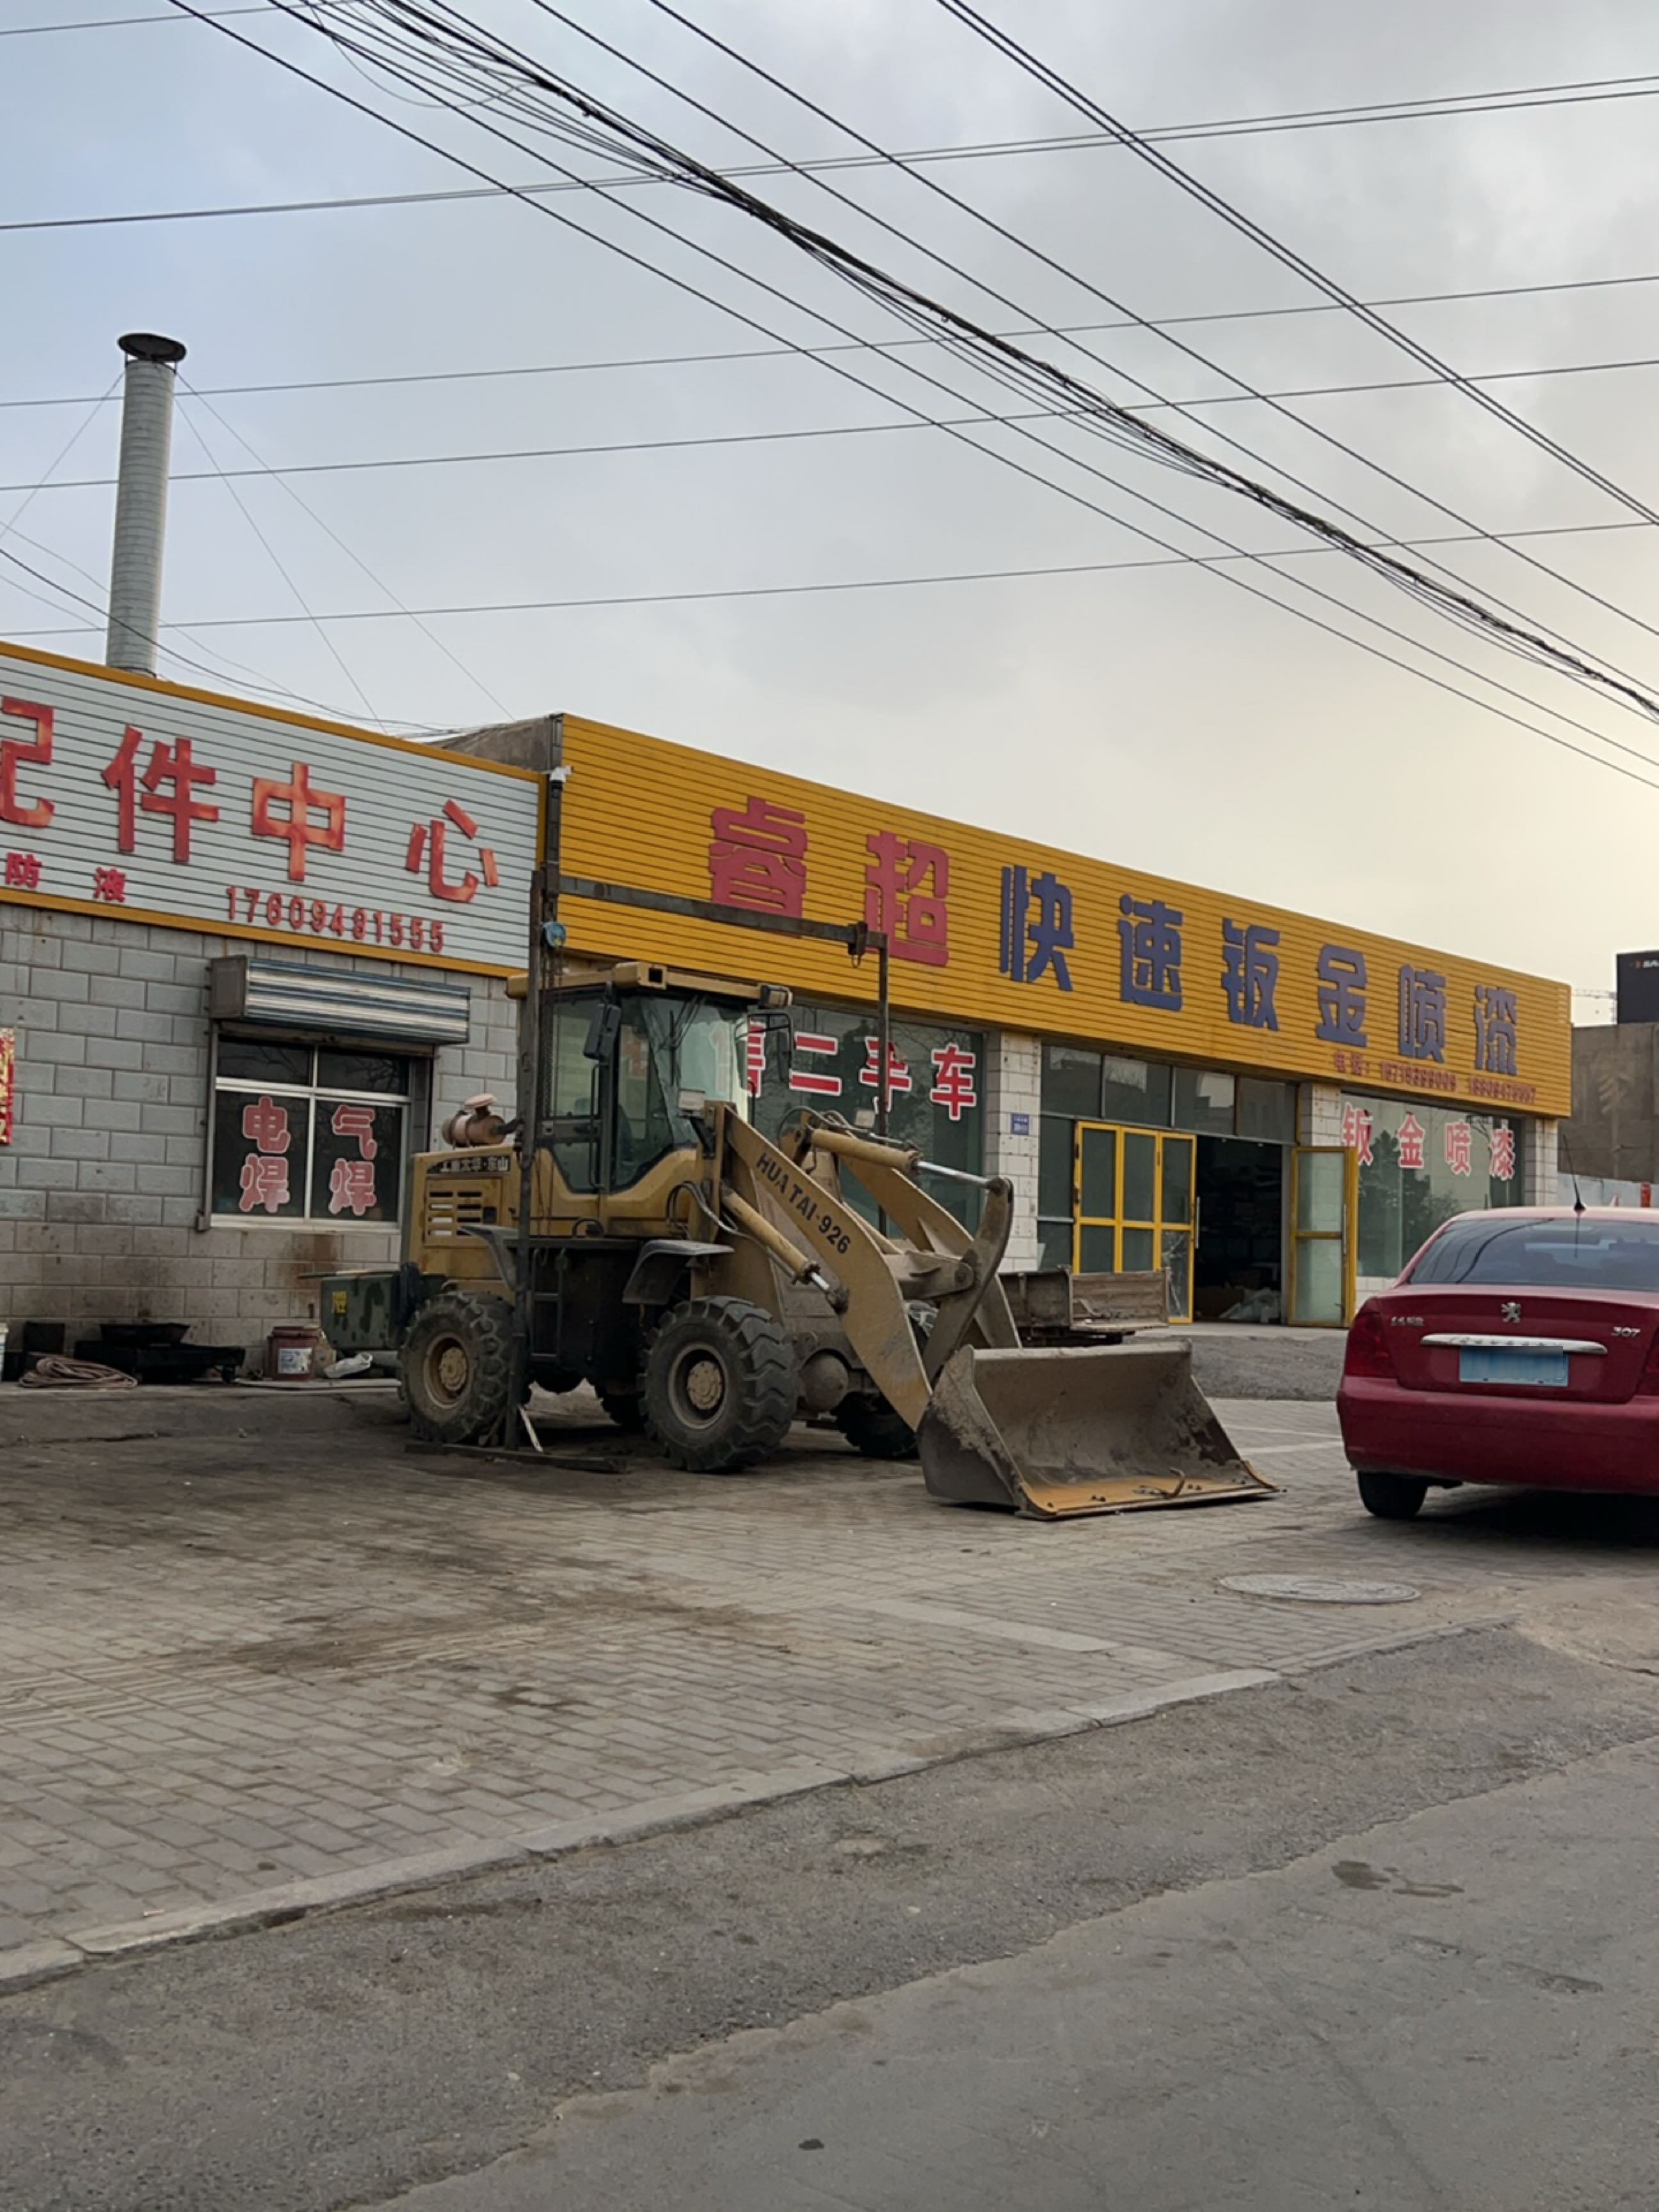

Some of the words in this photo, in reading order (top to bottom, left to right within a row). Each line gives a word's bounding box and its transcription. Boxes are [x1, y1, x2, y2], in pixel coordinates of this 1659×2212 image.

[226, 885, 444, 953] 17609481555
[240, 1096, 291, 1214] 电焊
[329, 1104, 378, 1216] 气焊
[1342, 1101, 1515, 1181] 钣金喷漆
